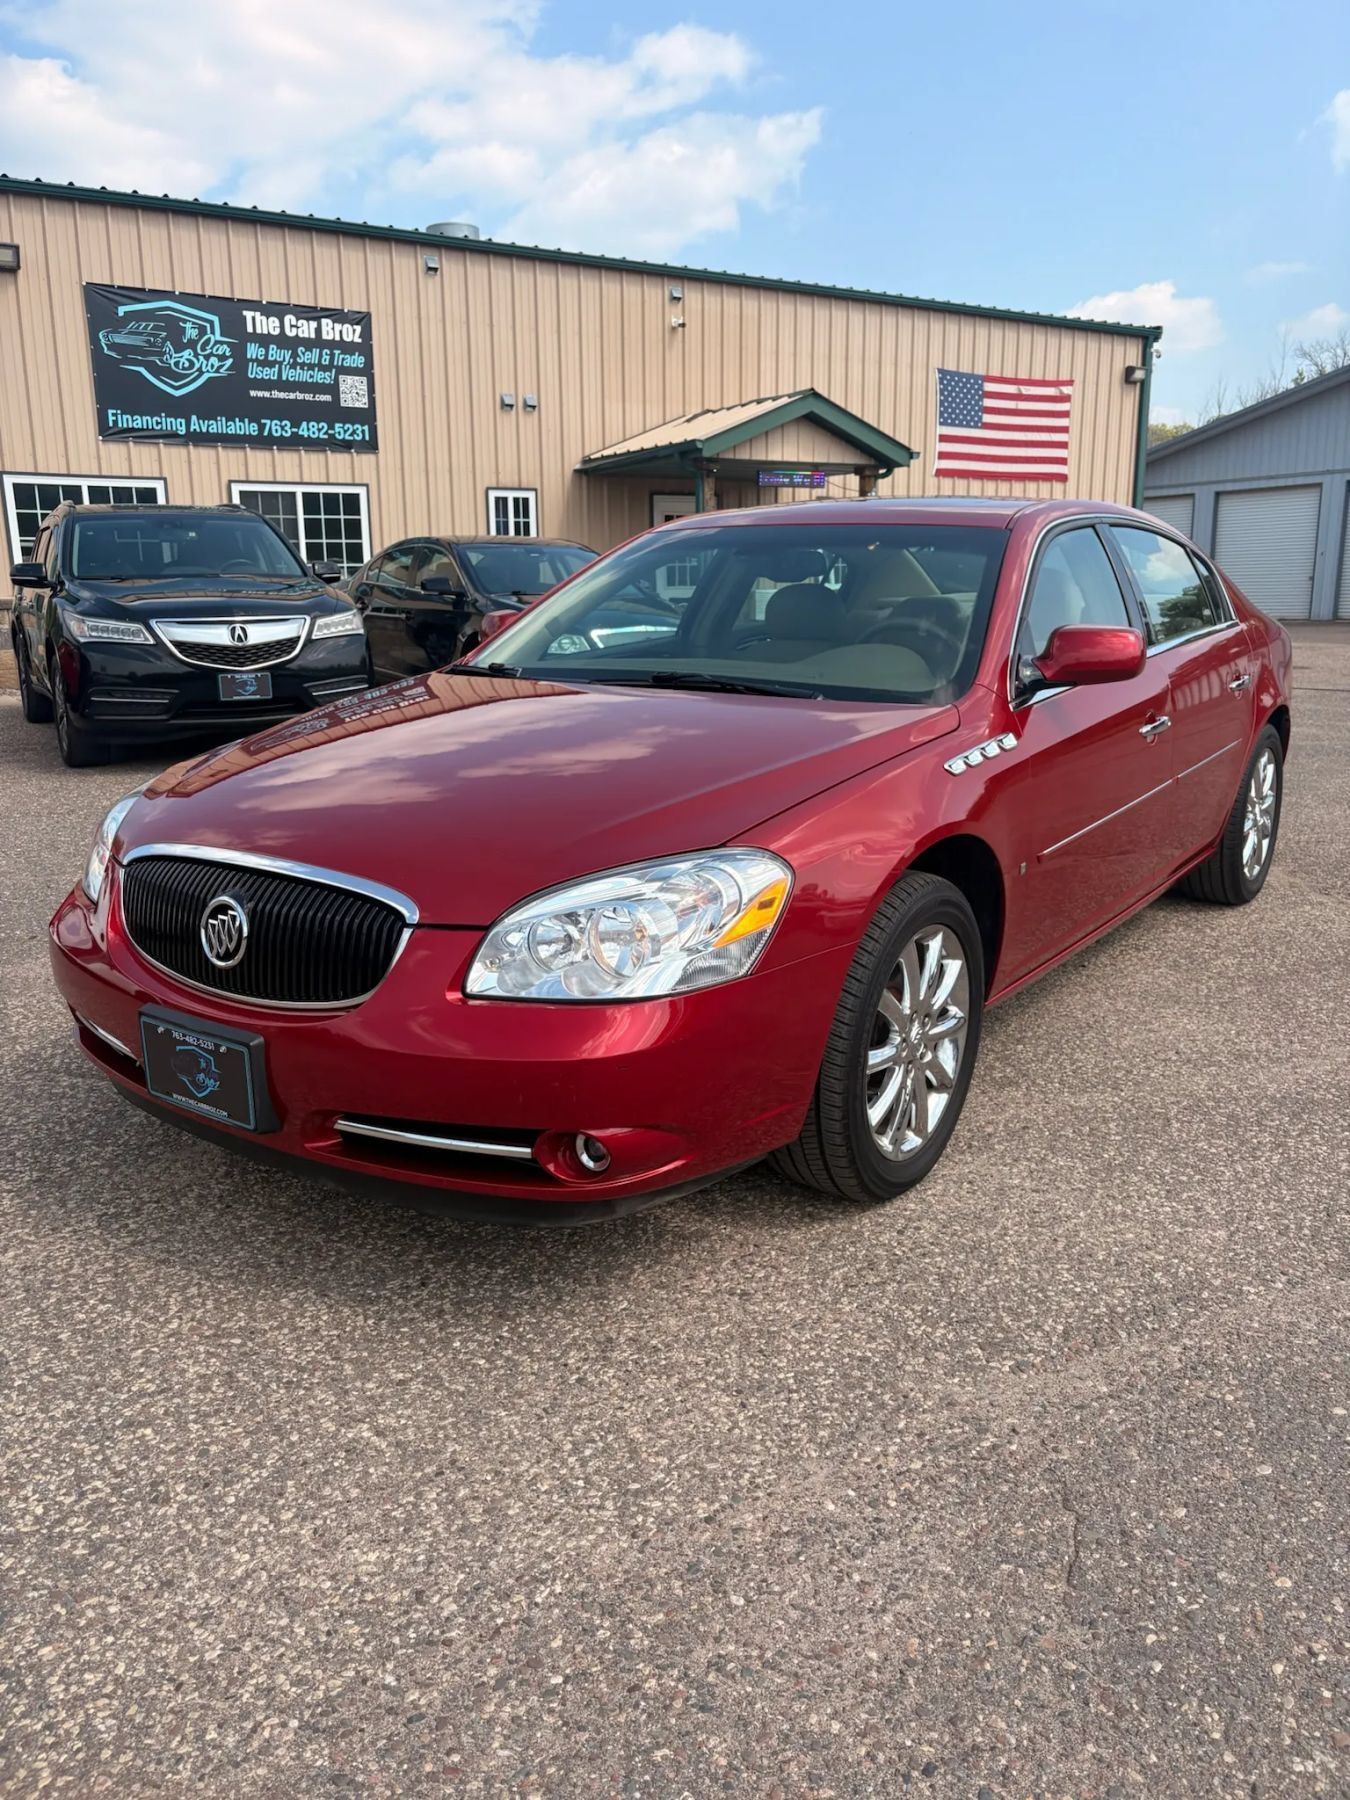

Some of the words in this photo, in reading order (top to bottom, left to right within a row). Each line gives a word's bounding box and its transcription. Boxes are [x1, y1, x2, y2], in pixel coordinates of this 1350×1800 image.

[179, 321, 199, 343] The
[242, 310, 280, 335] The
[284, 314, 318, 338] Car
[321, 318, 362, 343] Broz
[197, 334, 232, 356] Car
[246, 342, 265, 360] We
[268, 344, 293, 365] Buy,
[296, 347, 319, 364] Sell
[321, 349, 331, 365] &
[333, 350, 365, 368] Trade
[170, 349, 234, 373] Broz
[248, 362, 279, 380] Used
[281, 365, 336, 384] Vehicles!
[249, 389, 332, 402] www.thecarbroz.com
[107, 409, 186, 434] Financing
[189, 415, 258, 436] Available
[261, 419, 370, 441] 763-482-5231
